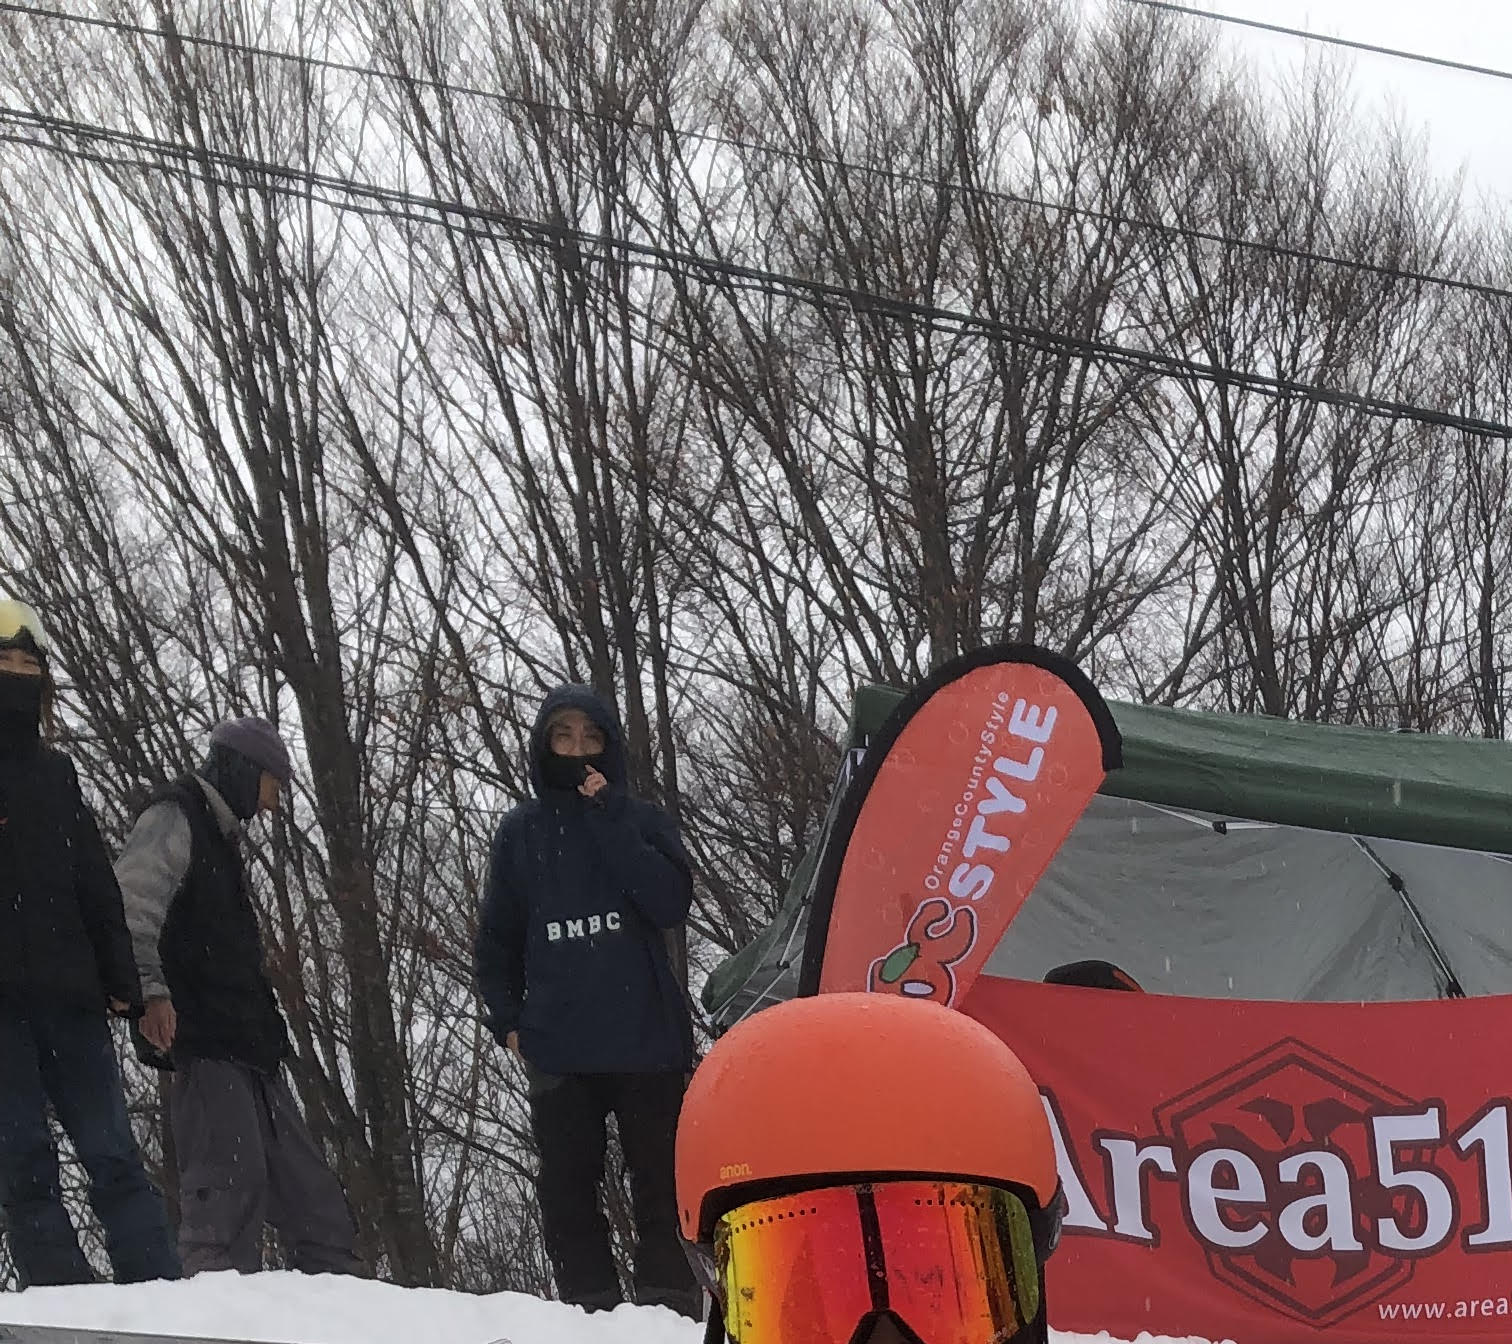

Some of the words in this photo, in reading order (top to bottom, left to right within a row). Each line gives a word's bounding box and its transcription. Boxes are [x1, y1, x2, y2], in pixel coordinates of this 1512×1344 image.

[924, 691, 1009, 890] OrangeCountyStyle
[948, 698, 1058, 901] STYLE
[546, 911, 621, 941] BMBC
